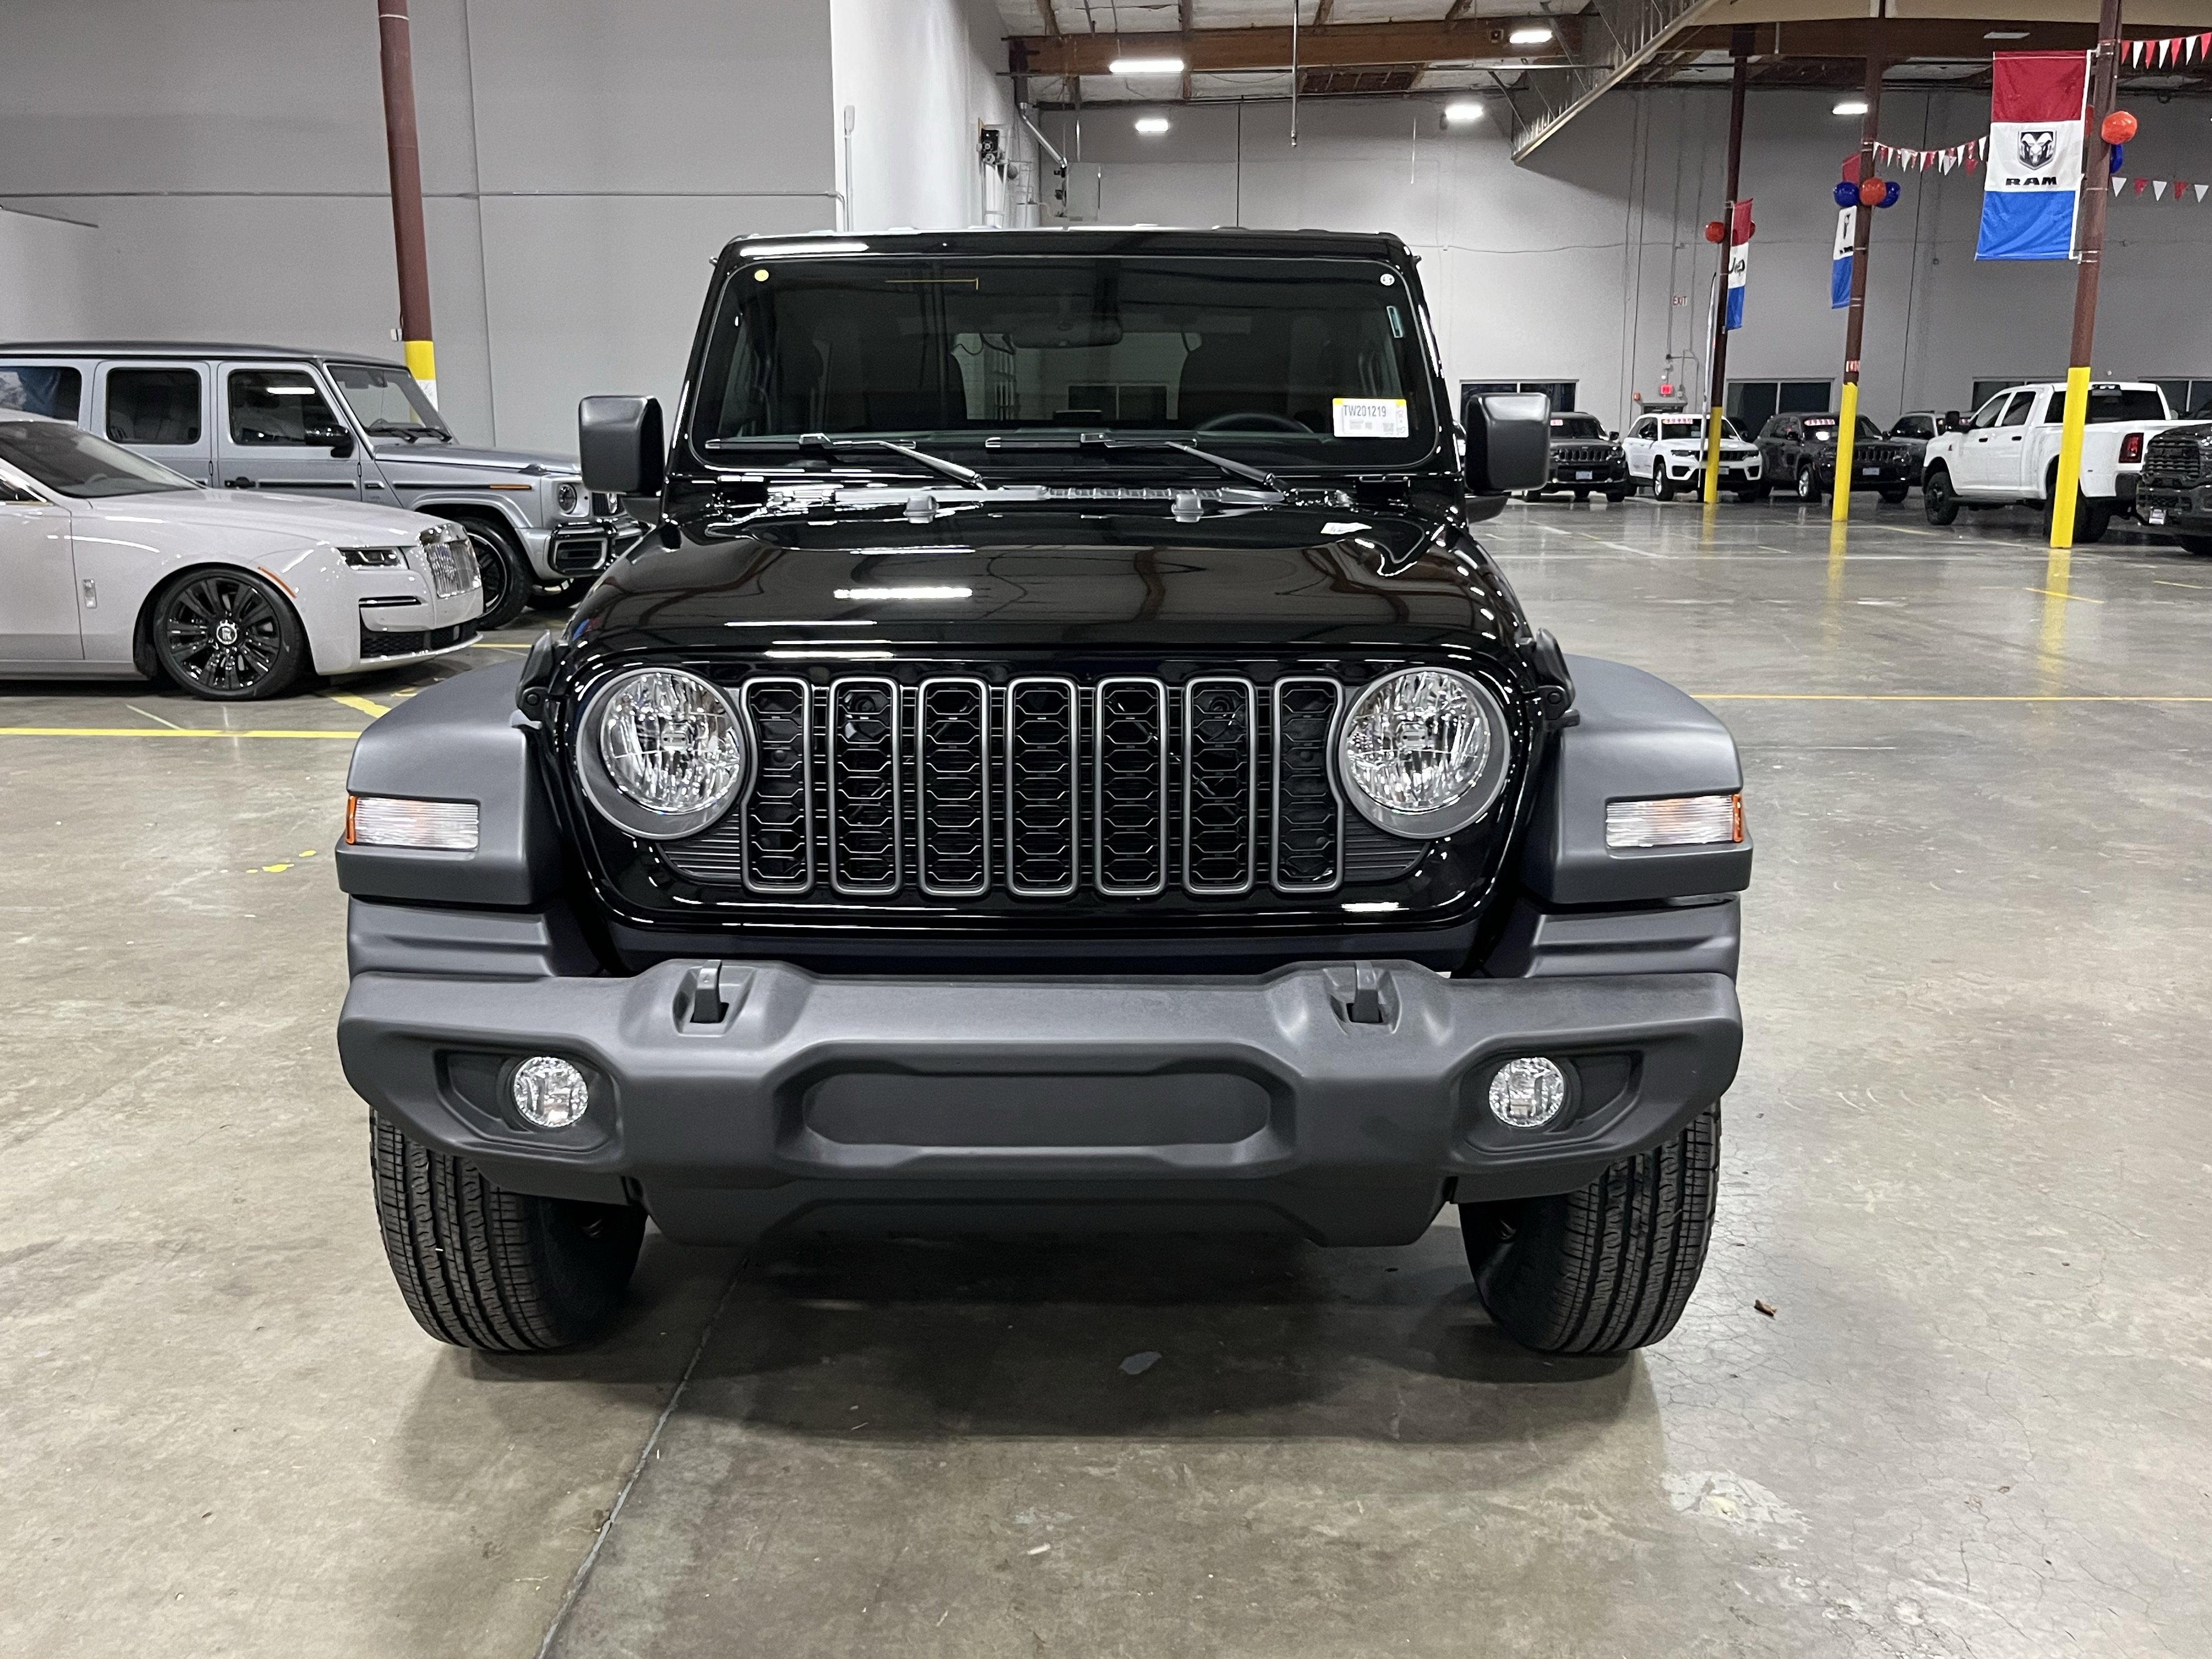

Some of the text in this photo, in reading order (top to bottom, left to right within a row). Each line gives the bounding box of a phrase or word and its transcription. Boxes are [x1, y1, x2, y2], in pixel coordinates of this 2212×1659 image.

[2006, 177, 2057, 185] RAM
[1673, 296, 1687, 306] EXIT
[1343, 405, 1386, 417] TW201219
